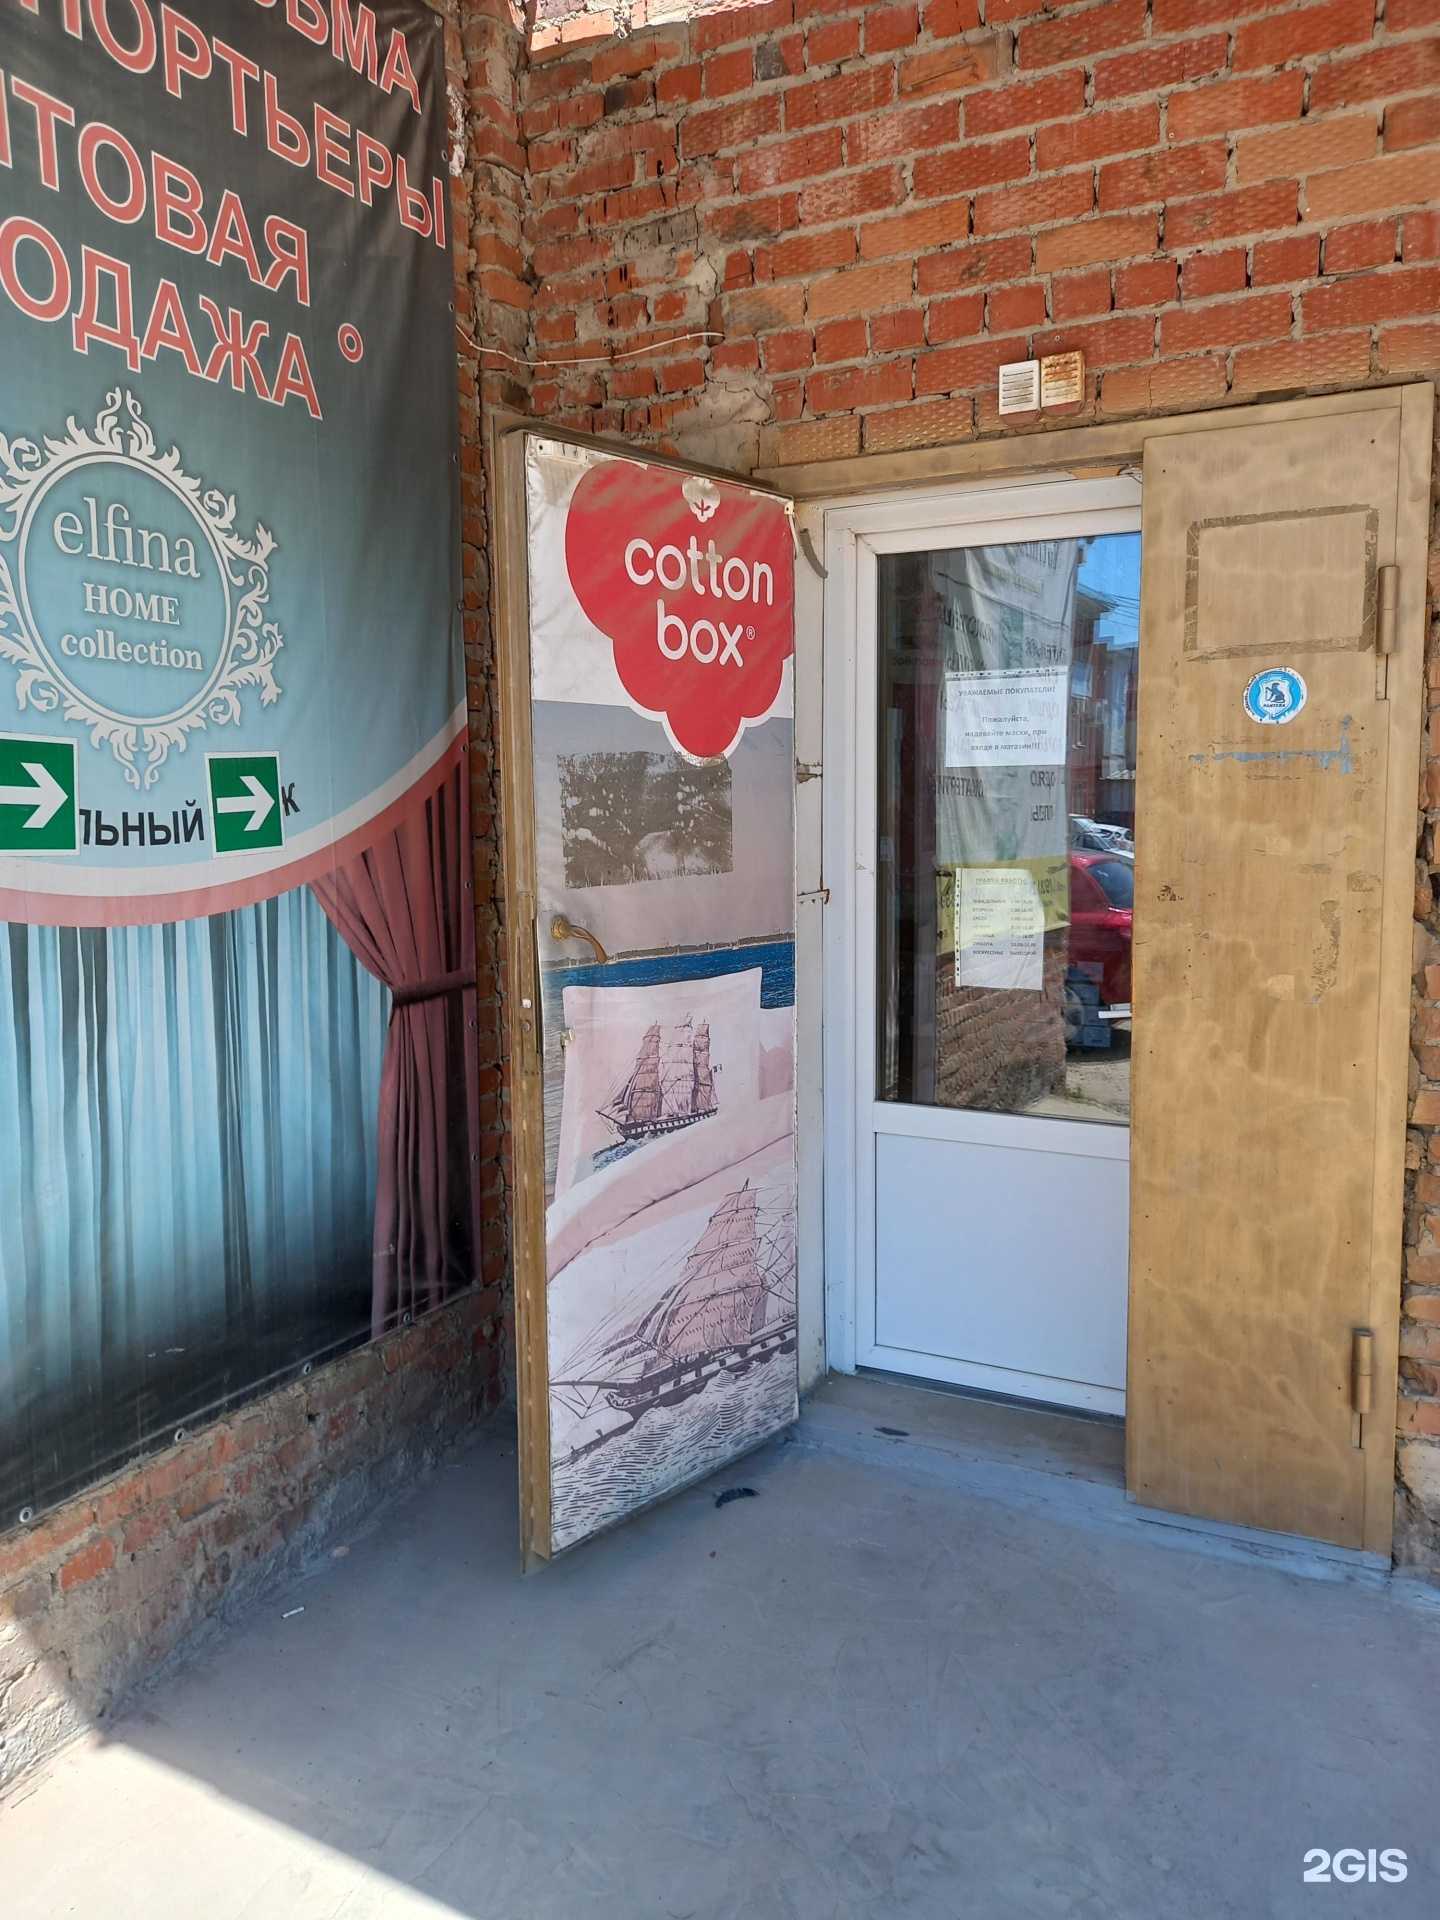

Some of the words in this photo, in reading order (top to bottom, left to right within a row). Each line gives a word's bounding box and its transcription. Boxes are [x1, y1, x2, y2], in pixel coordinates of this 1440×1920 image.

[0, 68, 311, 307] ТОВАЯ
[52, 496, 201, 578] elfina
[624, 535, 774, 606] cotton
[82, 582, 182, 627] HOME
[60, 629, 205, 671] collection
